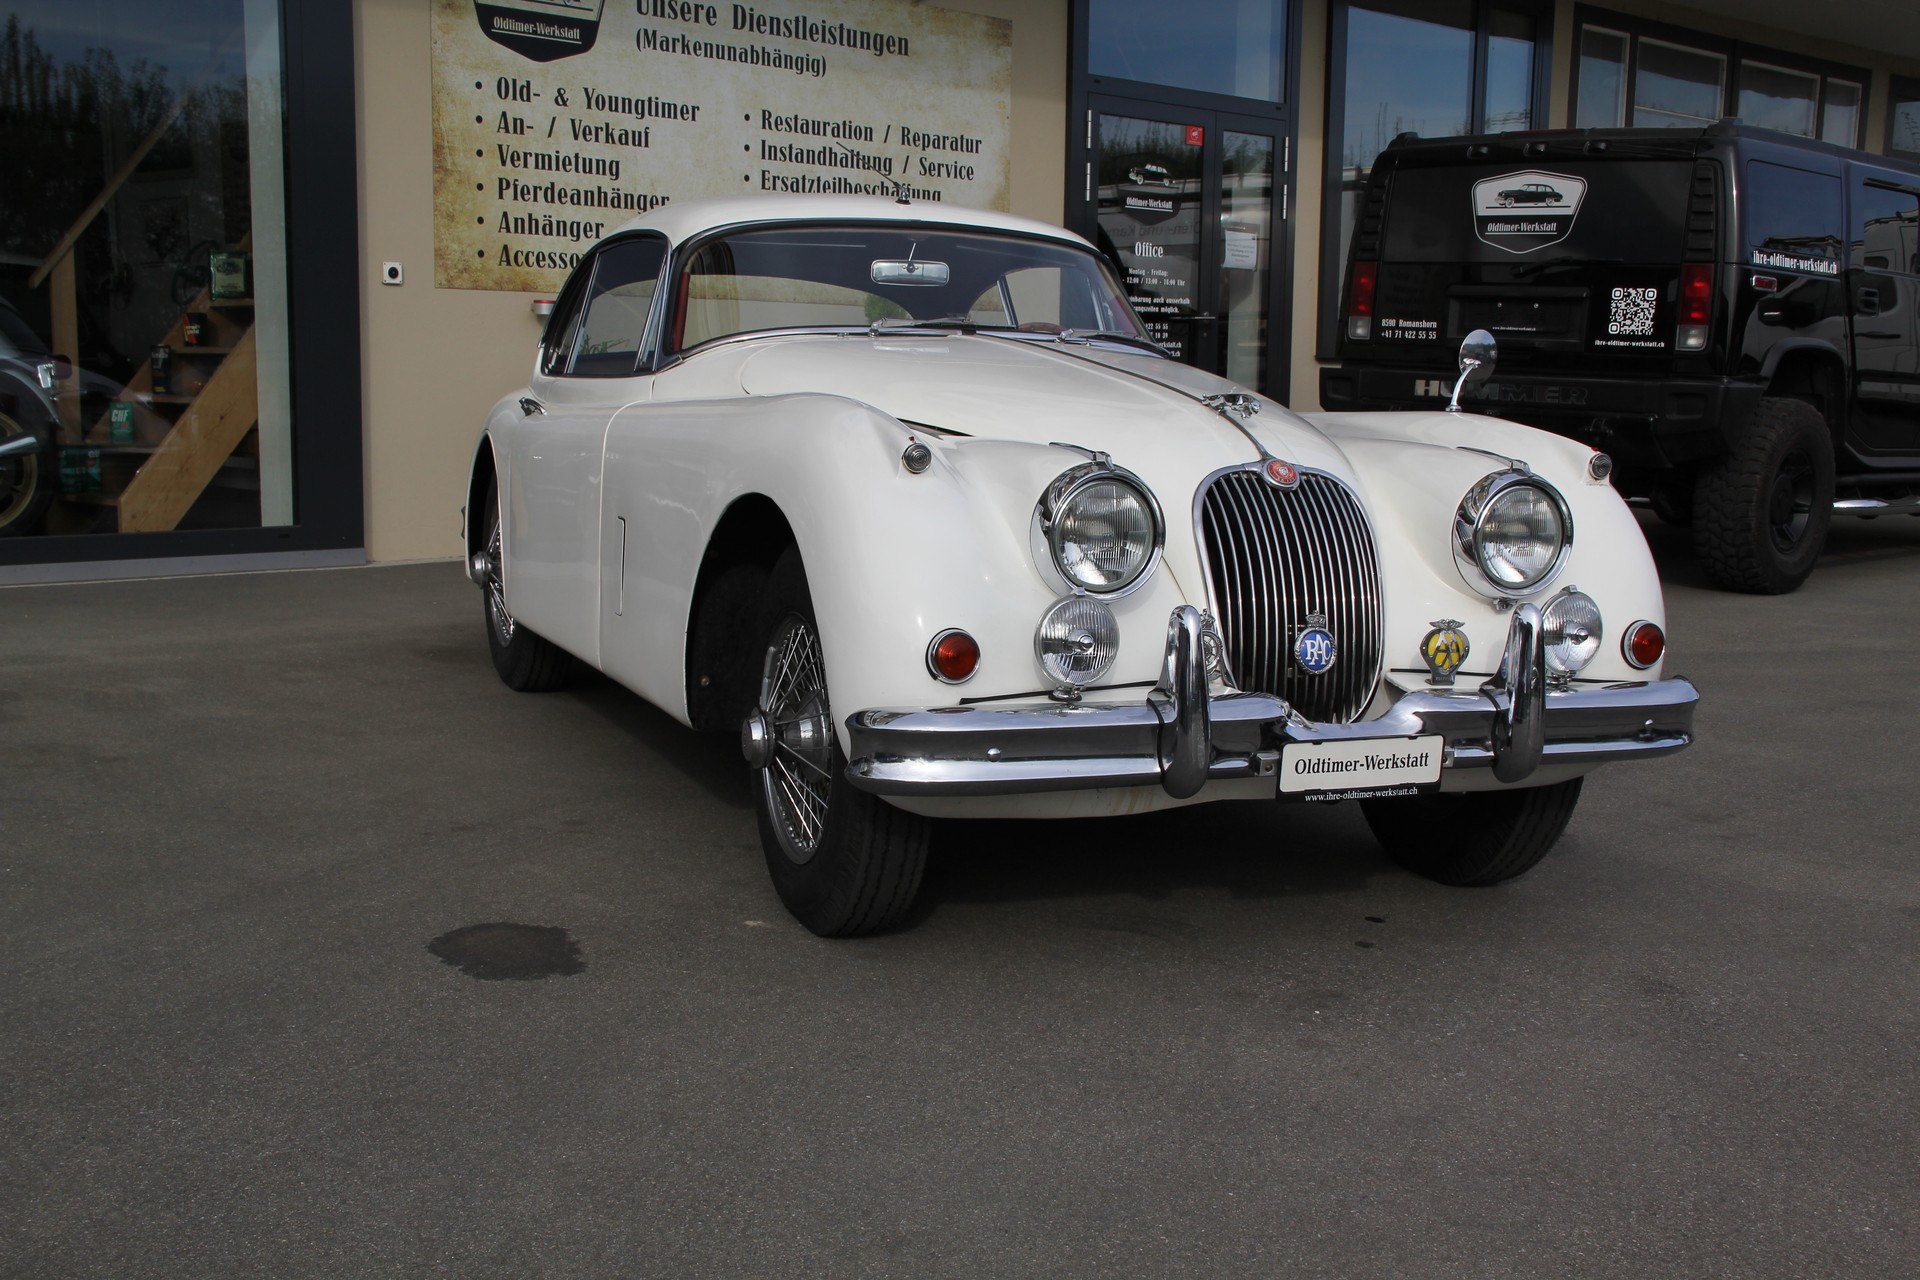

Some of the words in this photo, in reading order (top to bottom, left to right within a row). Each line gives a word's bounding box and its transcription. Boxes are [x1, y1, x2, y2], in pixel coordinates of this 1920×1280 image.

[493, 16, 580, 40] Oldtimer-Werkstatt
[636, 0, 717, 26] Unsere
[732, 4, 909, 56] Dienstleistungen
[636, 28, 827, 77] (Markenunabhängig)
[496, 76, 541, 103] Old-
[554, 87, 569, 107] &
[582, 86, 700, 122] Youngtimer
[496, 110, 534, 135] An-
[547, 116, 557, 138] /
[570, 118, 650, 148] Verkauf
[761, 109, 874, 142] Restauration
[883, 124, 891, 143] /
[901, 126, 982, 154] Reparatur
[496, 143, 620, 181] Vermietung
[761, 139, 893, 176] Instandhaltung
[902, 155, 910, 174] /
[919, 157, 974, 181] Service
[497, 176, 670, 215] Pferdeanhänger
[498, 211, 604, 242] Anhänger
[1487, 222, 1557, 232] Oldtimer-Werkstatt
[498, 244, 585, 269] Accesso
[1135, 241, 1164, 258] Office
[1151, 269, 1169, 277] Freitag:
[1753, 250, 1837, 275] ihre-oldtimer-werkstatt.ch
[1381, 318, 1396, 327] 8590
[1398, 319, 1437, 328] Romanshorn
[1381, 330, 1392, 338] +41
[1394, 330, 1402, 338] 71
[1405, 331, 1416, 339] 422
[1418, 331, 1426, 339] 55
[1428, 331, 1437, 340] 55
[1594, 339, 1665, 348] ihre-oldtimer-werkstatt.ch
[1414, 379, 1588, 405] HUMMER
[111, 409, 129, 422] CHF
[1305, 634, 1332, 665] RAC
[1294, 751, 1429, 775] Oldtimer-Werkstatt
[1304, 786, 1418, 801] www.ihre-oldtimer-werkstatt.ch
